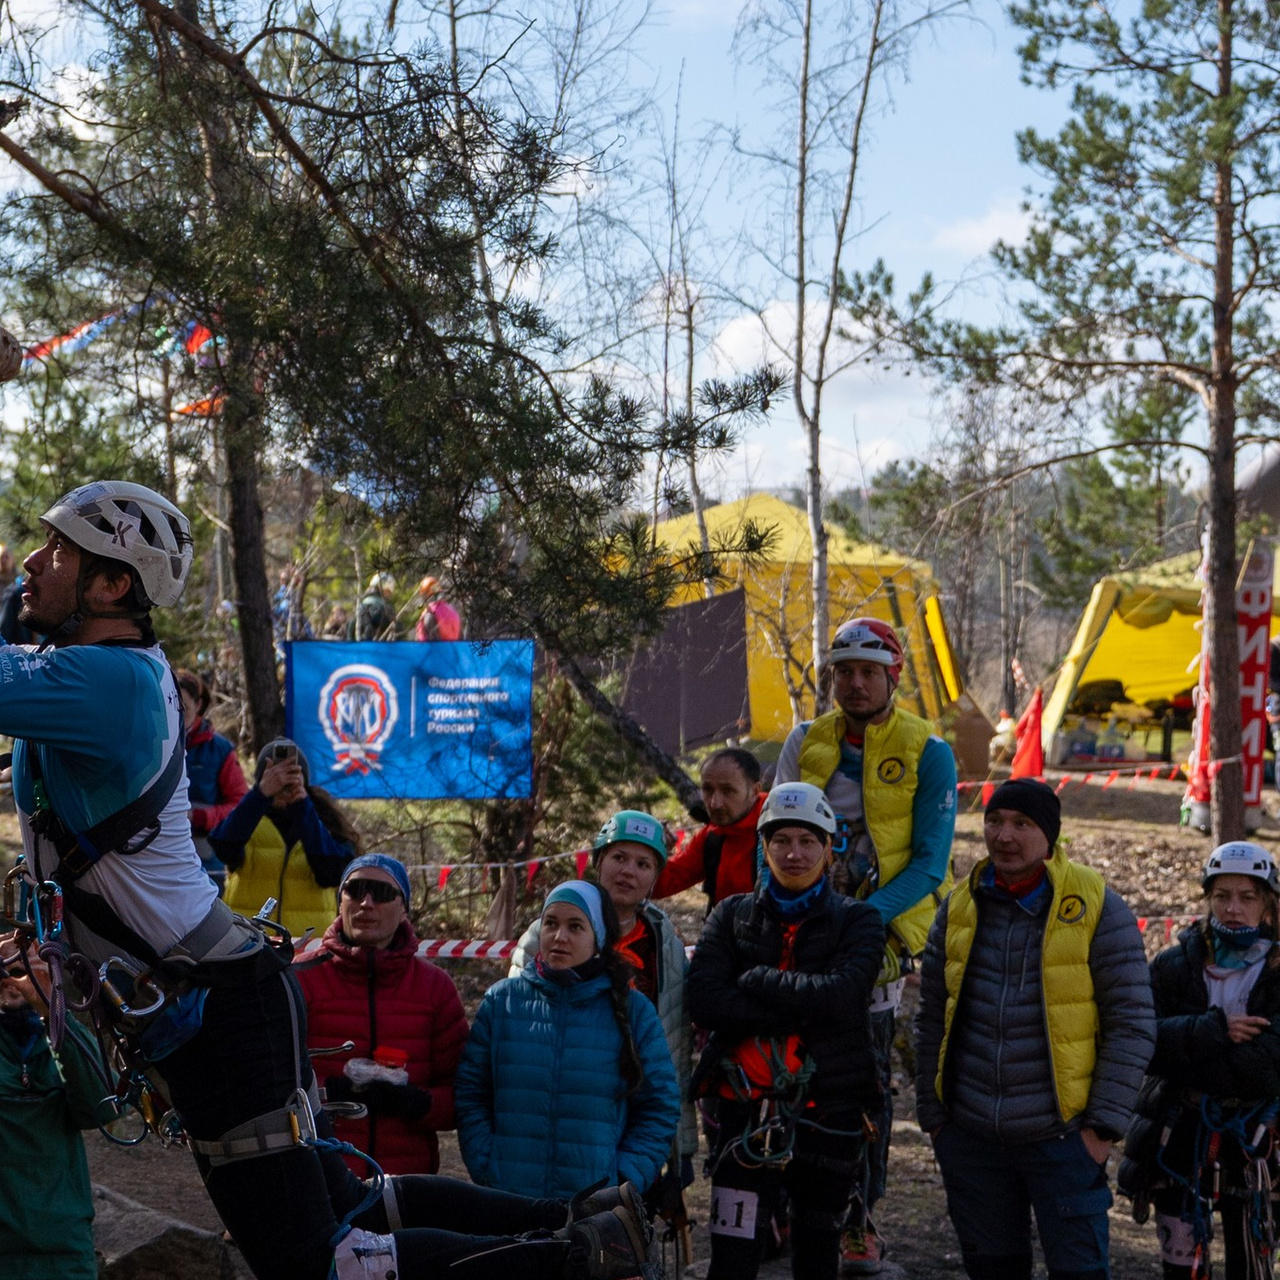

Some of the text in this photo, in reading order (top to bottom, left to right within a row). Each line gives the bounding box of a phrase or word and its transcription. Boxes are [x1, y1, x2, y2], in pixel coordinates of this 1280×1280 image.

[428, 676, 499, 690] Федерация
[427, 721, 475, 734] России
[633, 825, 648, 835] 4.2
[1161, 1225, 1197, 1258] 2.
